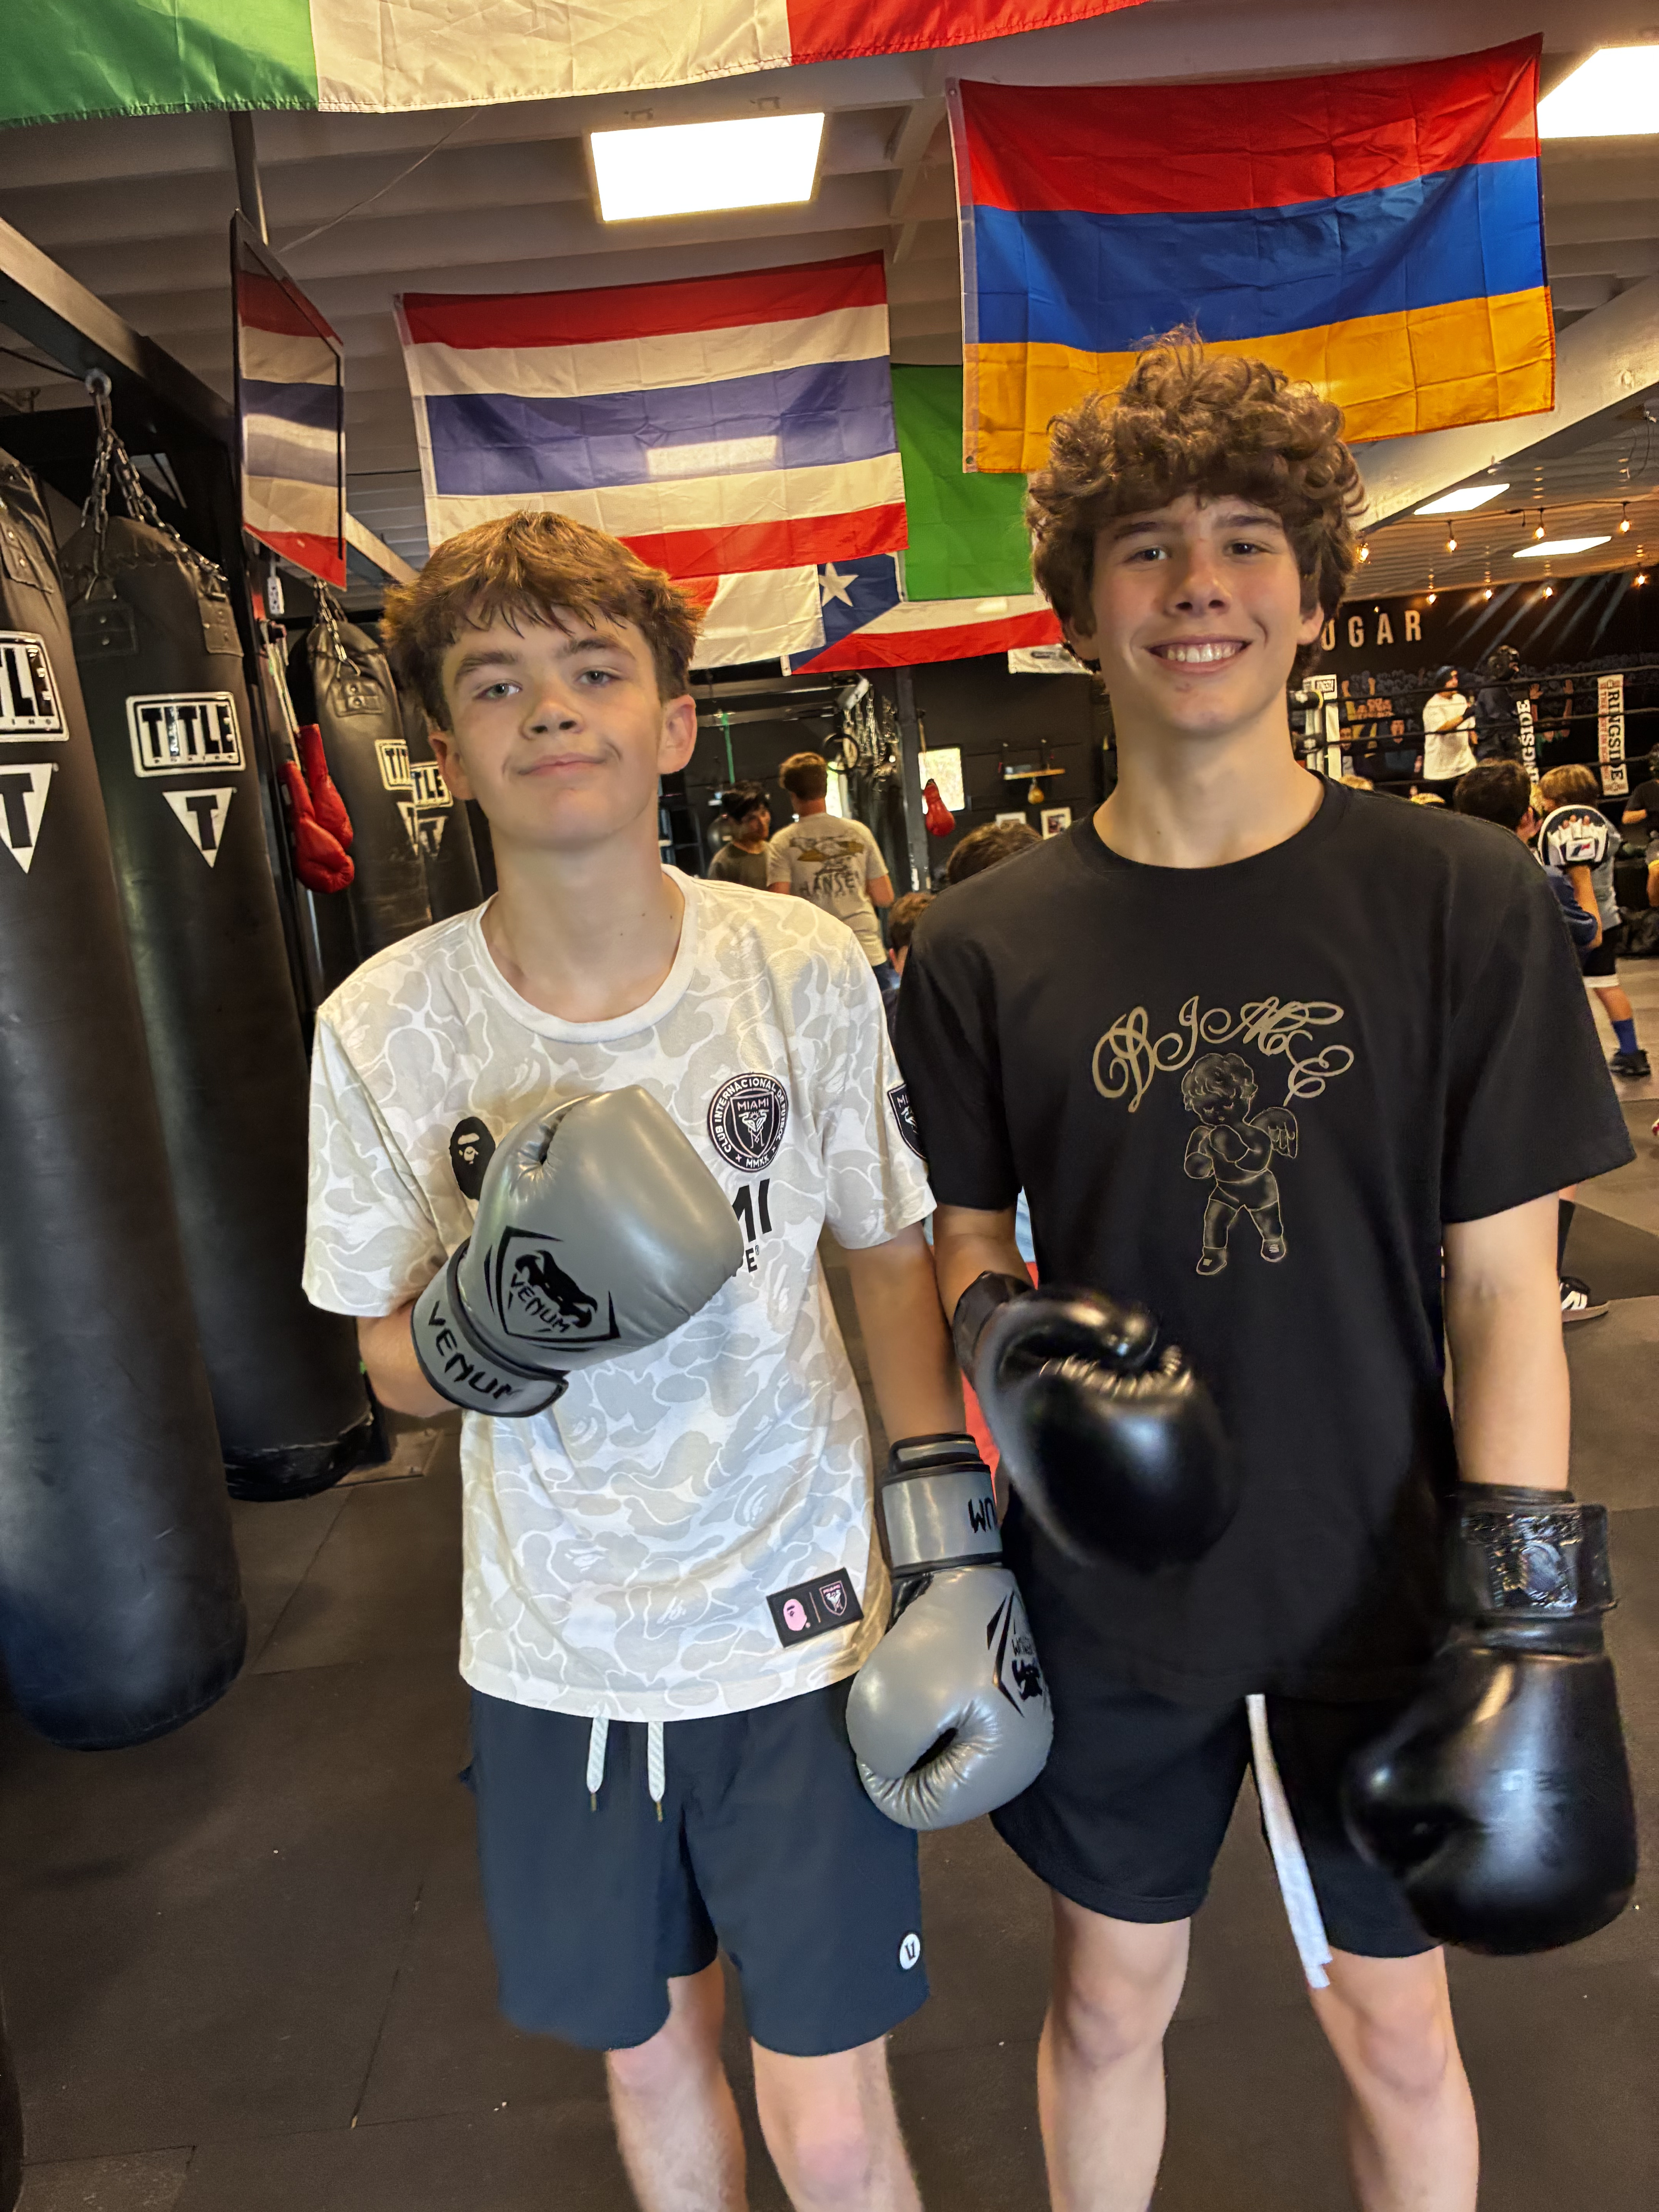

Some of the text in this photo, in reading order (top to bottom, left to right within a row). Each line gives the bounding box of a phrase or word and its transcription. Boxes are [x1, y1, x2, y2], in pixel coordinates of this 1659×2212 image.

[1321, 610, 1422, 651] UGAR
[141, 704, 237, 758] TITLE
[187, 796, 218, 850] T
[714, 1077, 776, 1123] INTERNACIONAL
[737, 1097, 769, 1111] MIAMI
[715, 1125, 732, 1153] CLUB
[510, 1272, 570, 1333] VENUM
